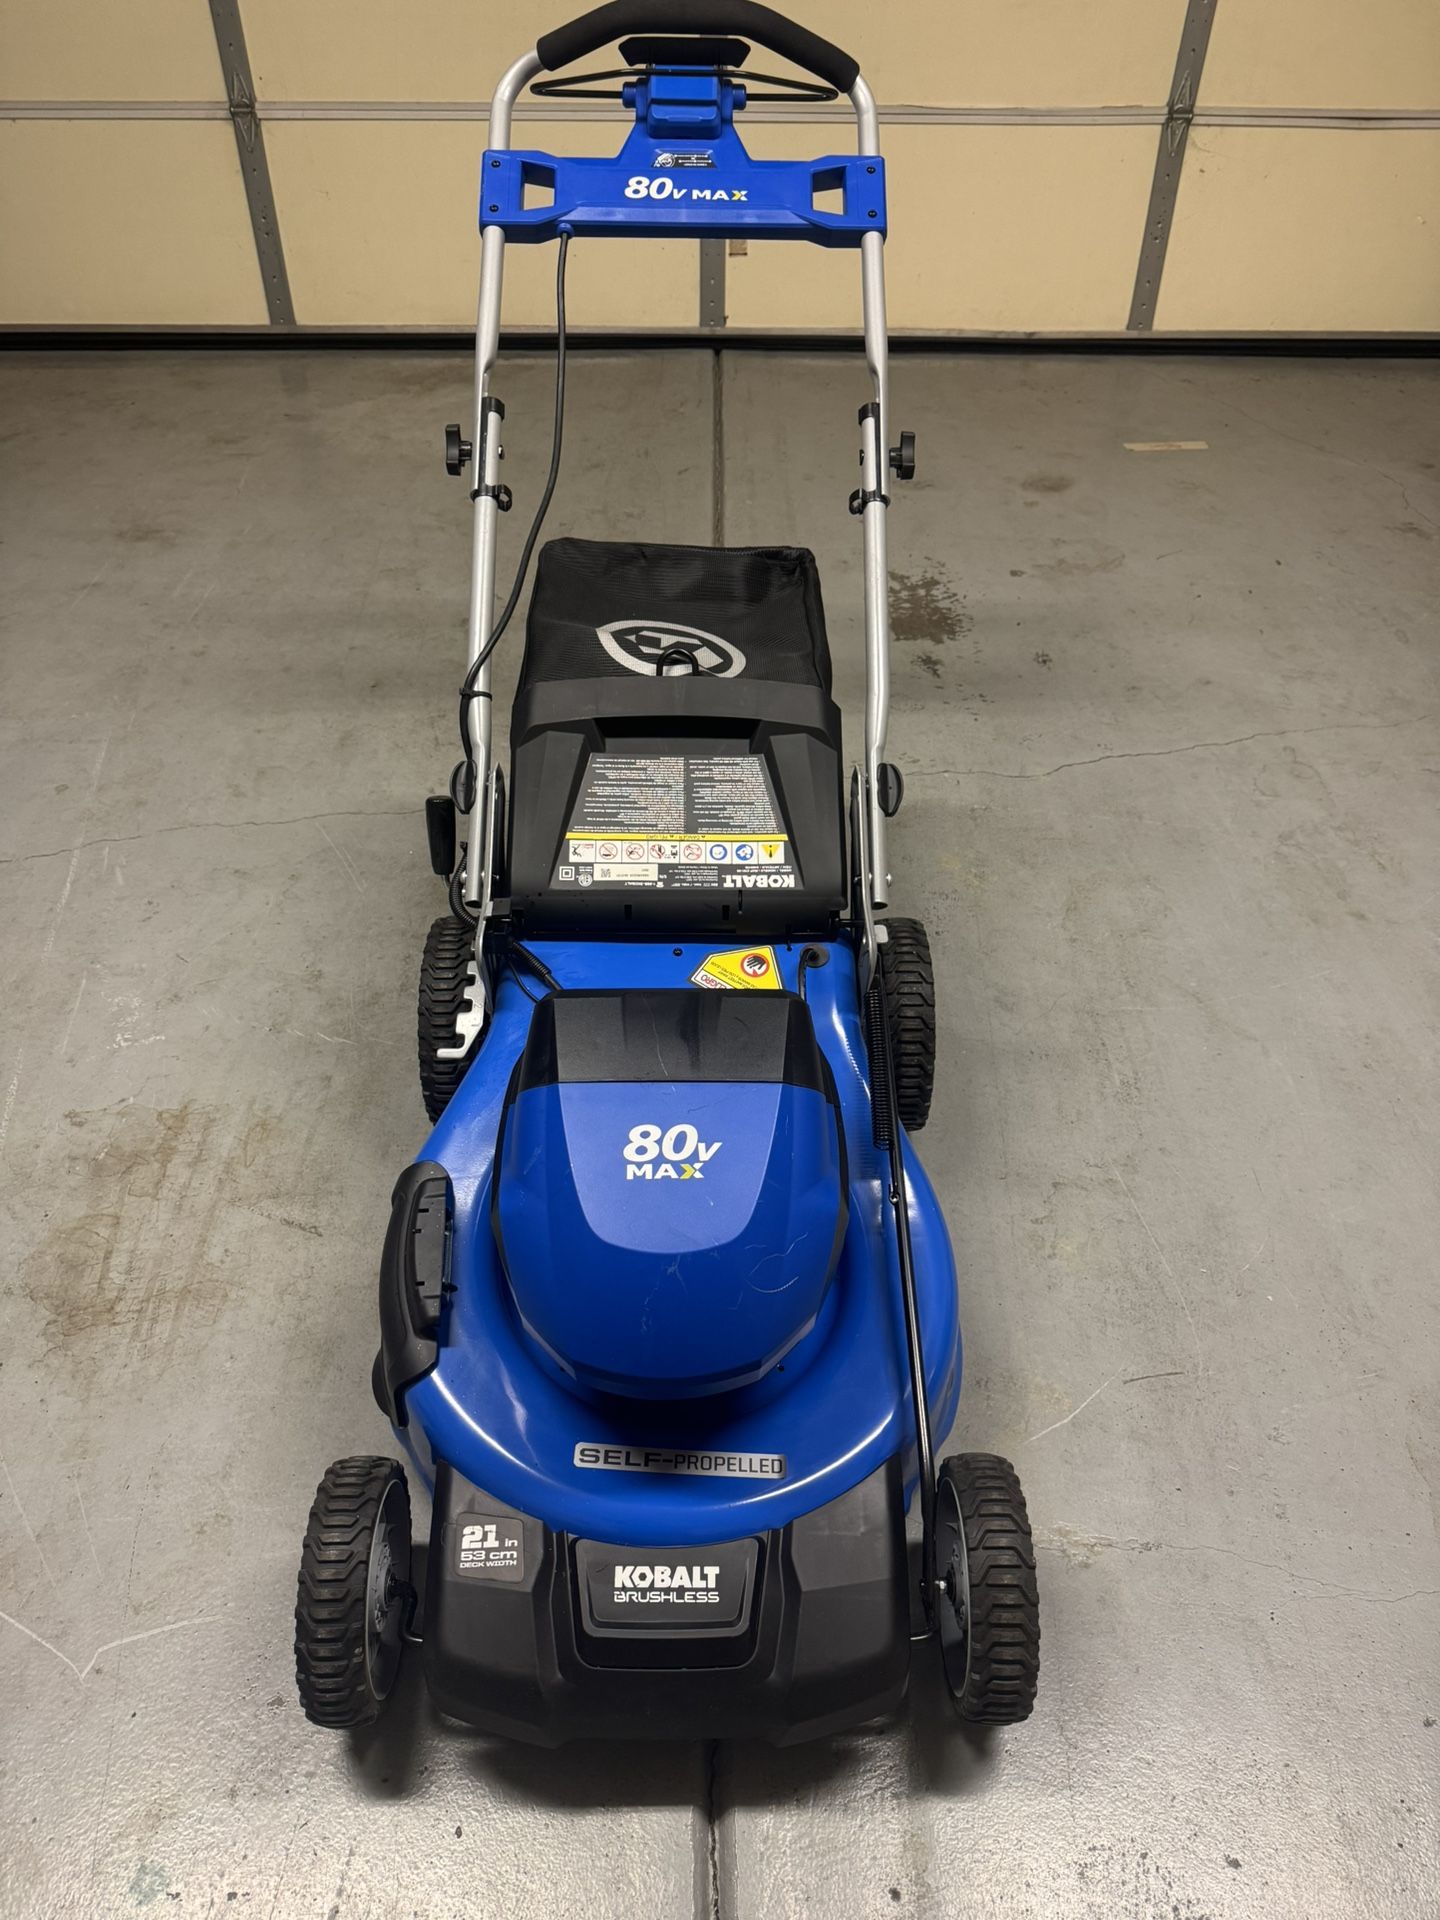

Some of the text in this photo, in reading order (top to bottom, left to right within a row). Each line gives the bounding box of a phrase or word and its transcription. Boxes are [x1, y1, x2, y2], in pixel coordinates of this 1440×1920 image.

[692, 189, 749, 201] MAX
[723, 874, 795, 888] KOBALT
[626, 1162, 705, 1180] MAX
[578, 1447, 783, 1474] SELF-PROPELLED
[461, 1524, 518, 1550] 21 in
[460, 1550, 518, 1561] 53 cm
[459, 1561, 485, 1569] DECK
[614, 1565, 720, 1588] KOBALT
[613, 1591, 720, 1603] BRUSHLESS
